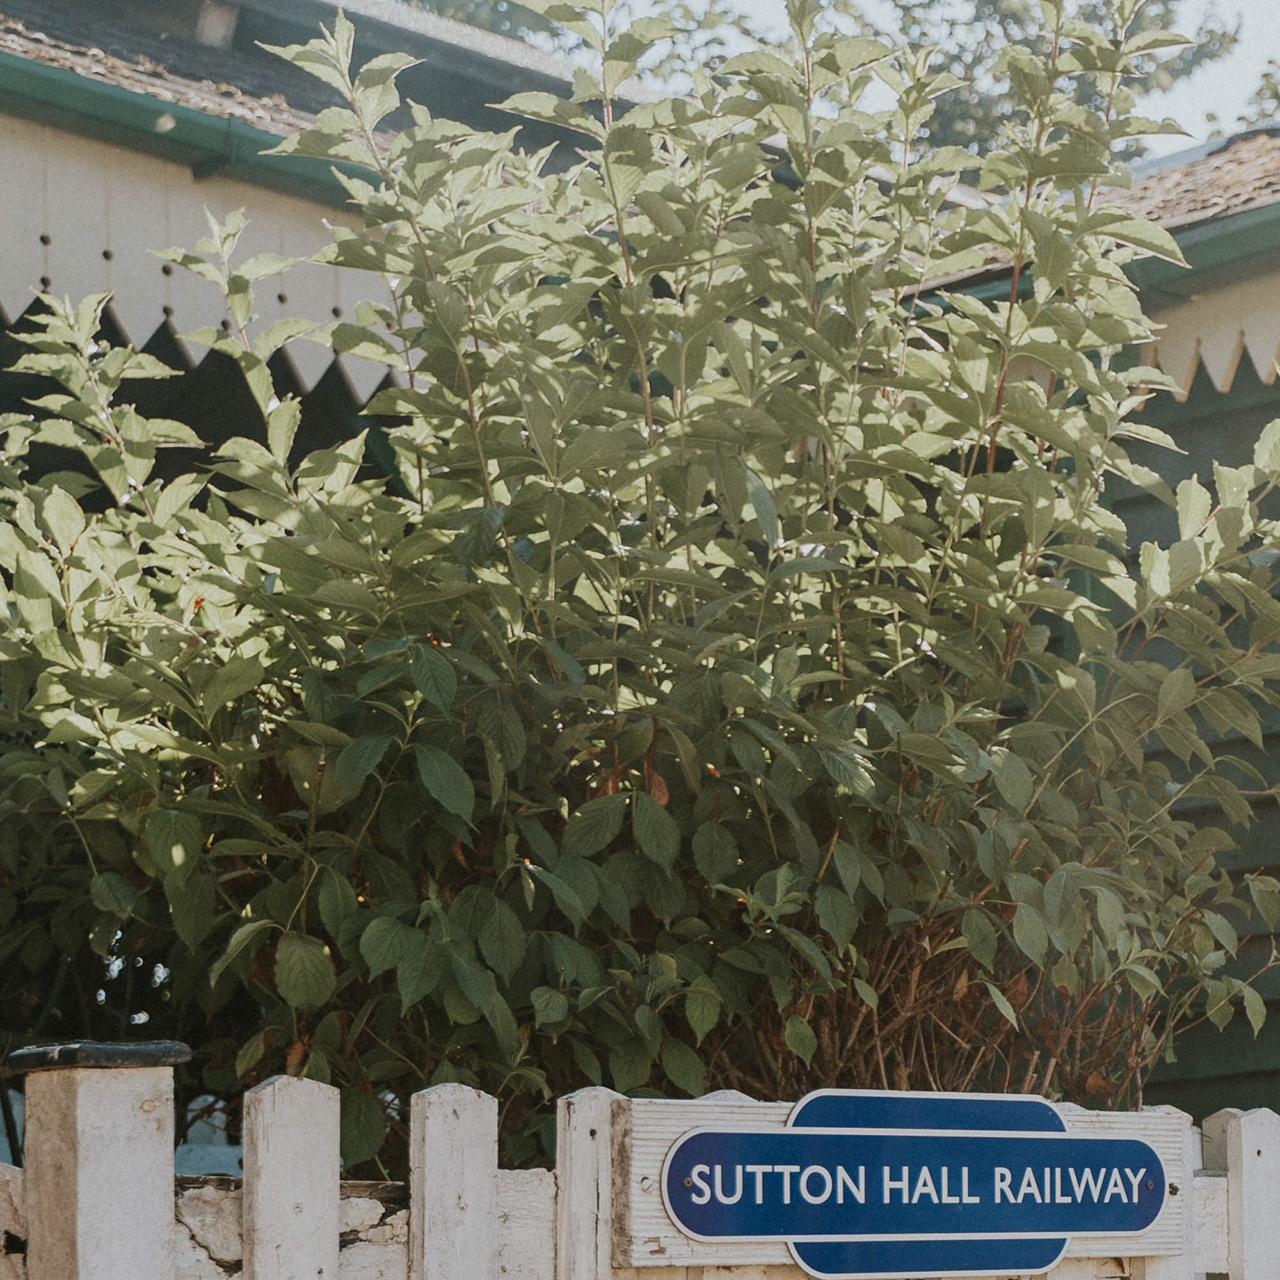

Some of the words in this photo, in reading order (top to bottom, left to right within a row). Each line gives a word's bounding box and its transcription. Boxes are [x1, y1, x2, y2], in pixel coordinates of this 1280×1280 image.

[691, 1164, 866, 1205] SUTTON
[883, 1165, 981, 1204] HALL
[994, 1166, 1147, 1204] RAILWAY
